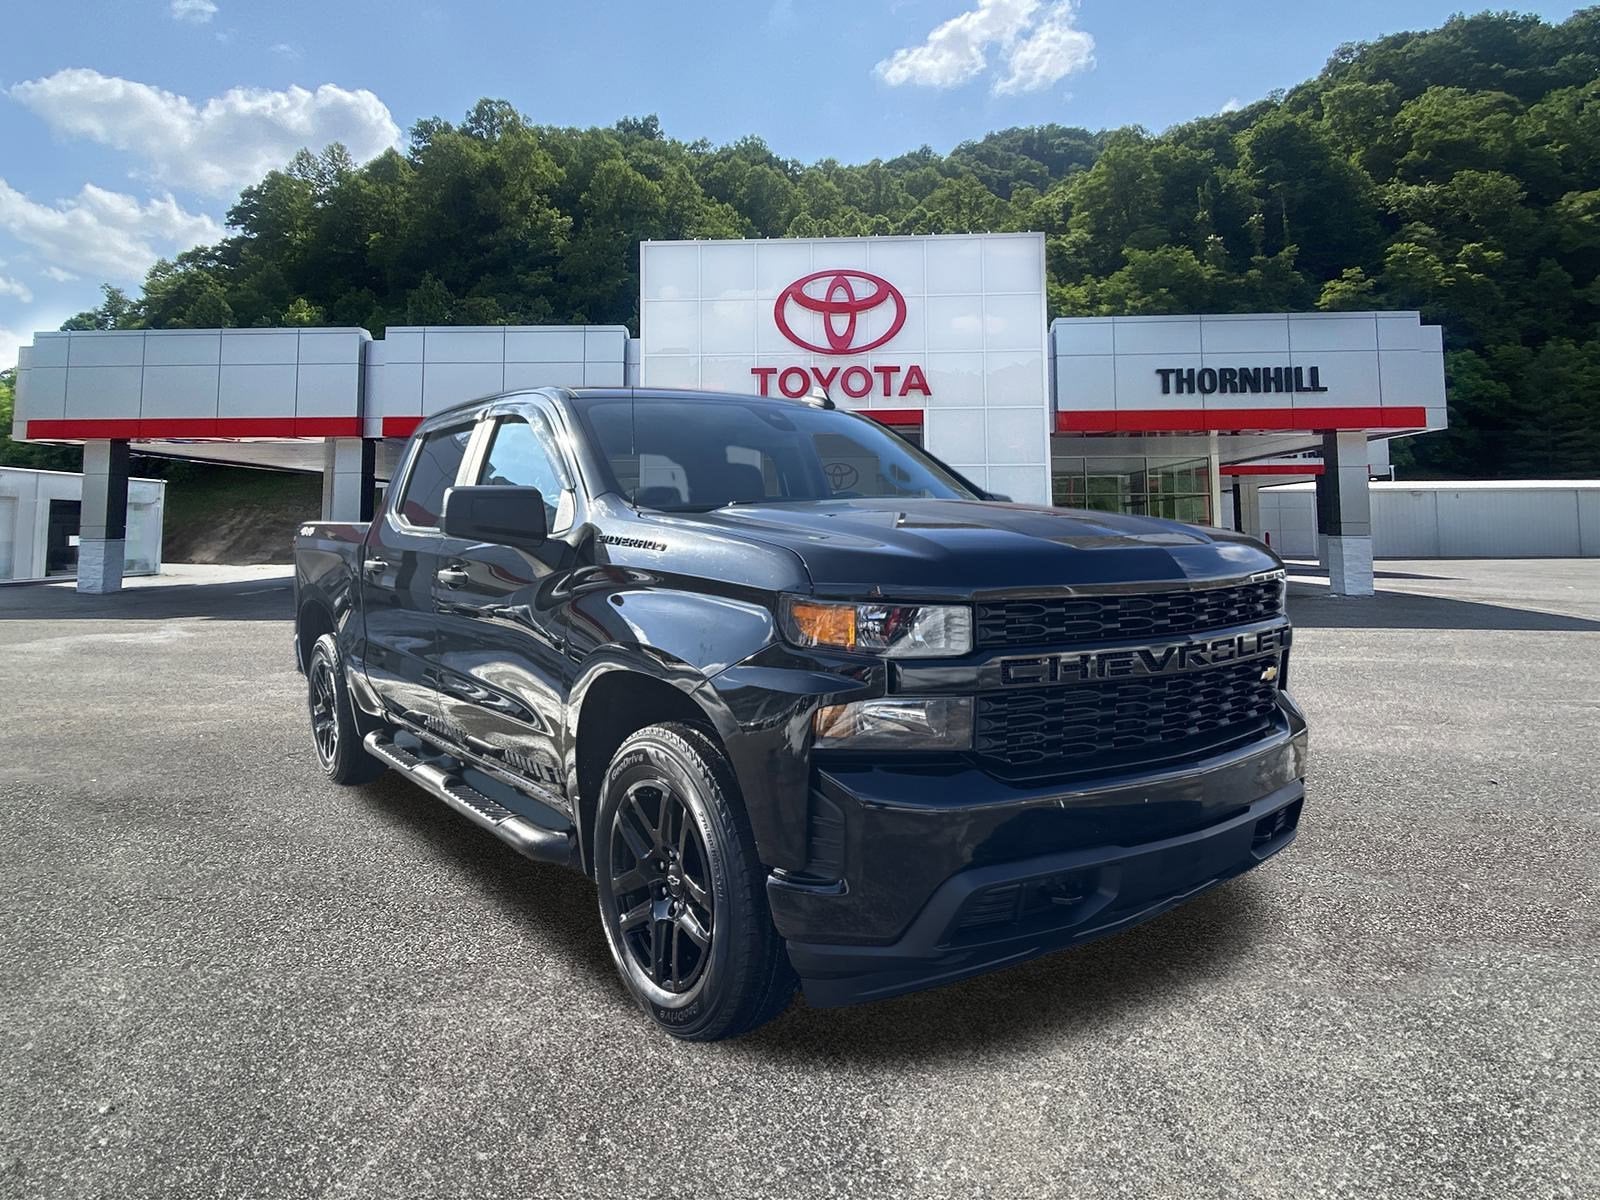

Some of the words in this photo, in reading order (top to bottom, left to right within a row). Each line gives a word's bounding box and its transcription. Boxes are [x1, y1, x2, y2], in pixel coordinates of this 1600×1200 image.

[751, 365, 932, 398] TOYOTA
[1156, 366, 1328, 394] THORNHILL
[1001, 626, 1290, 685] CHEVROLET
